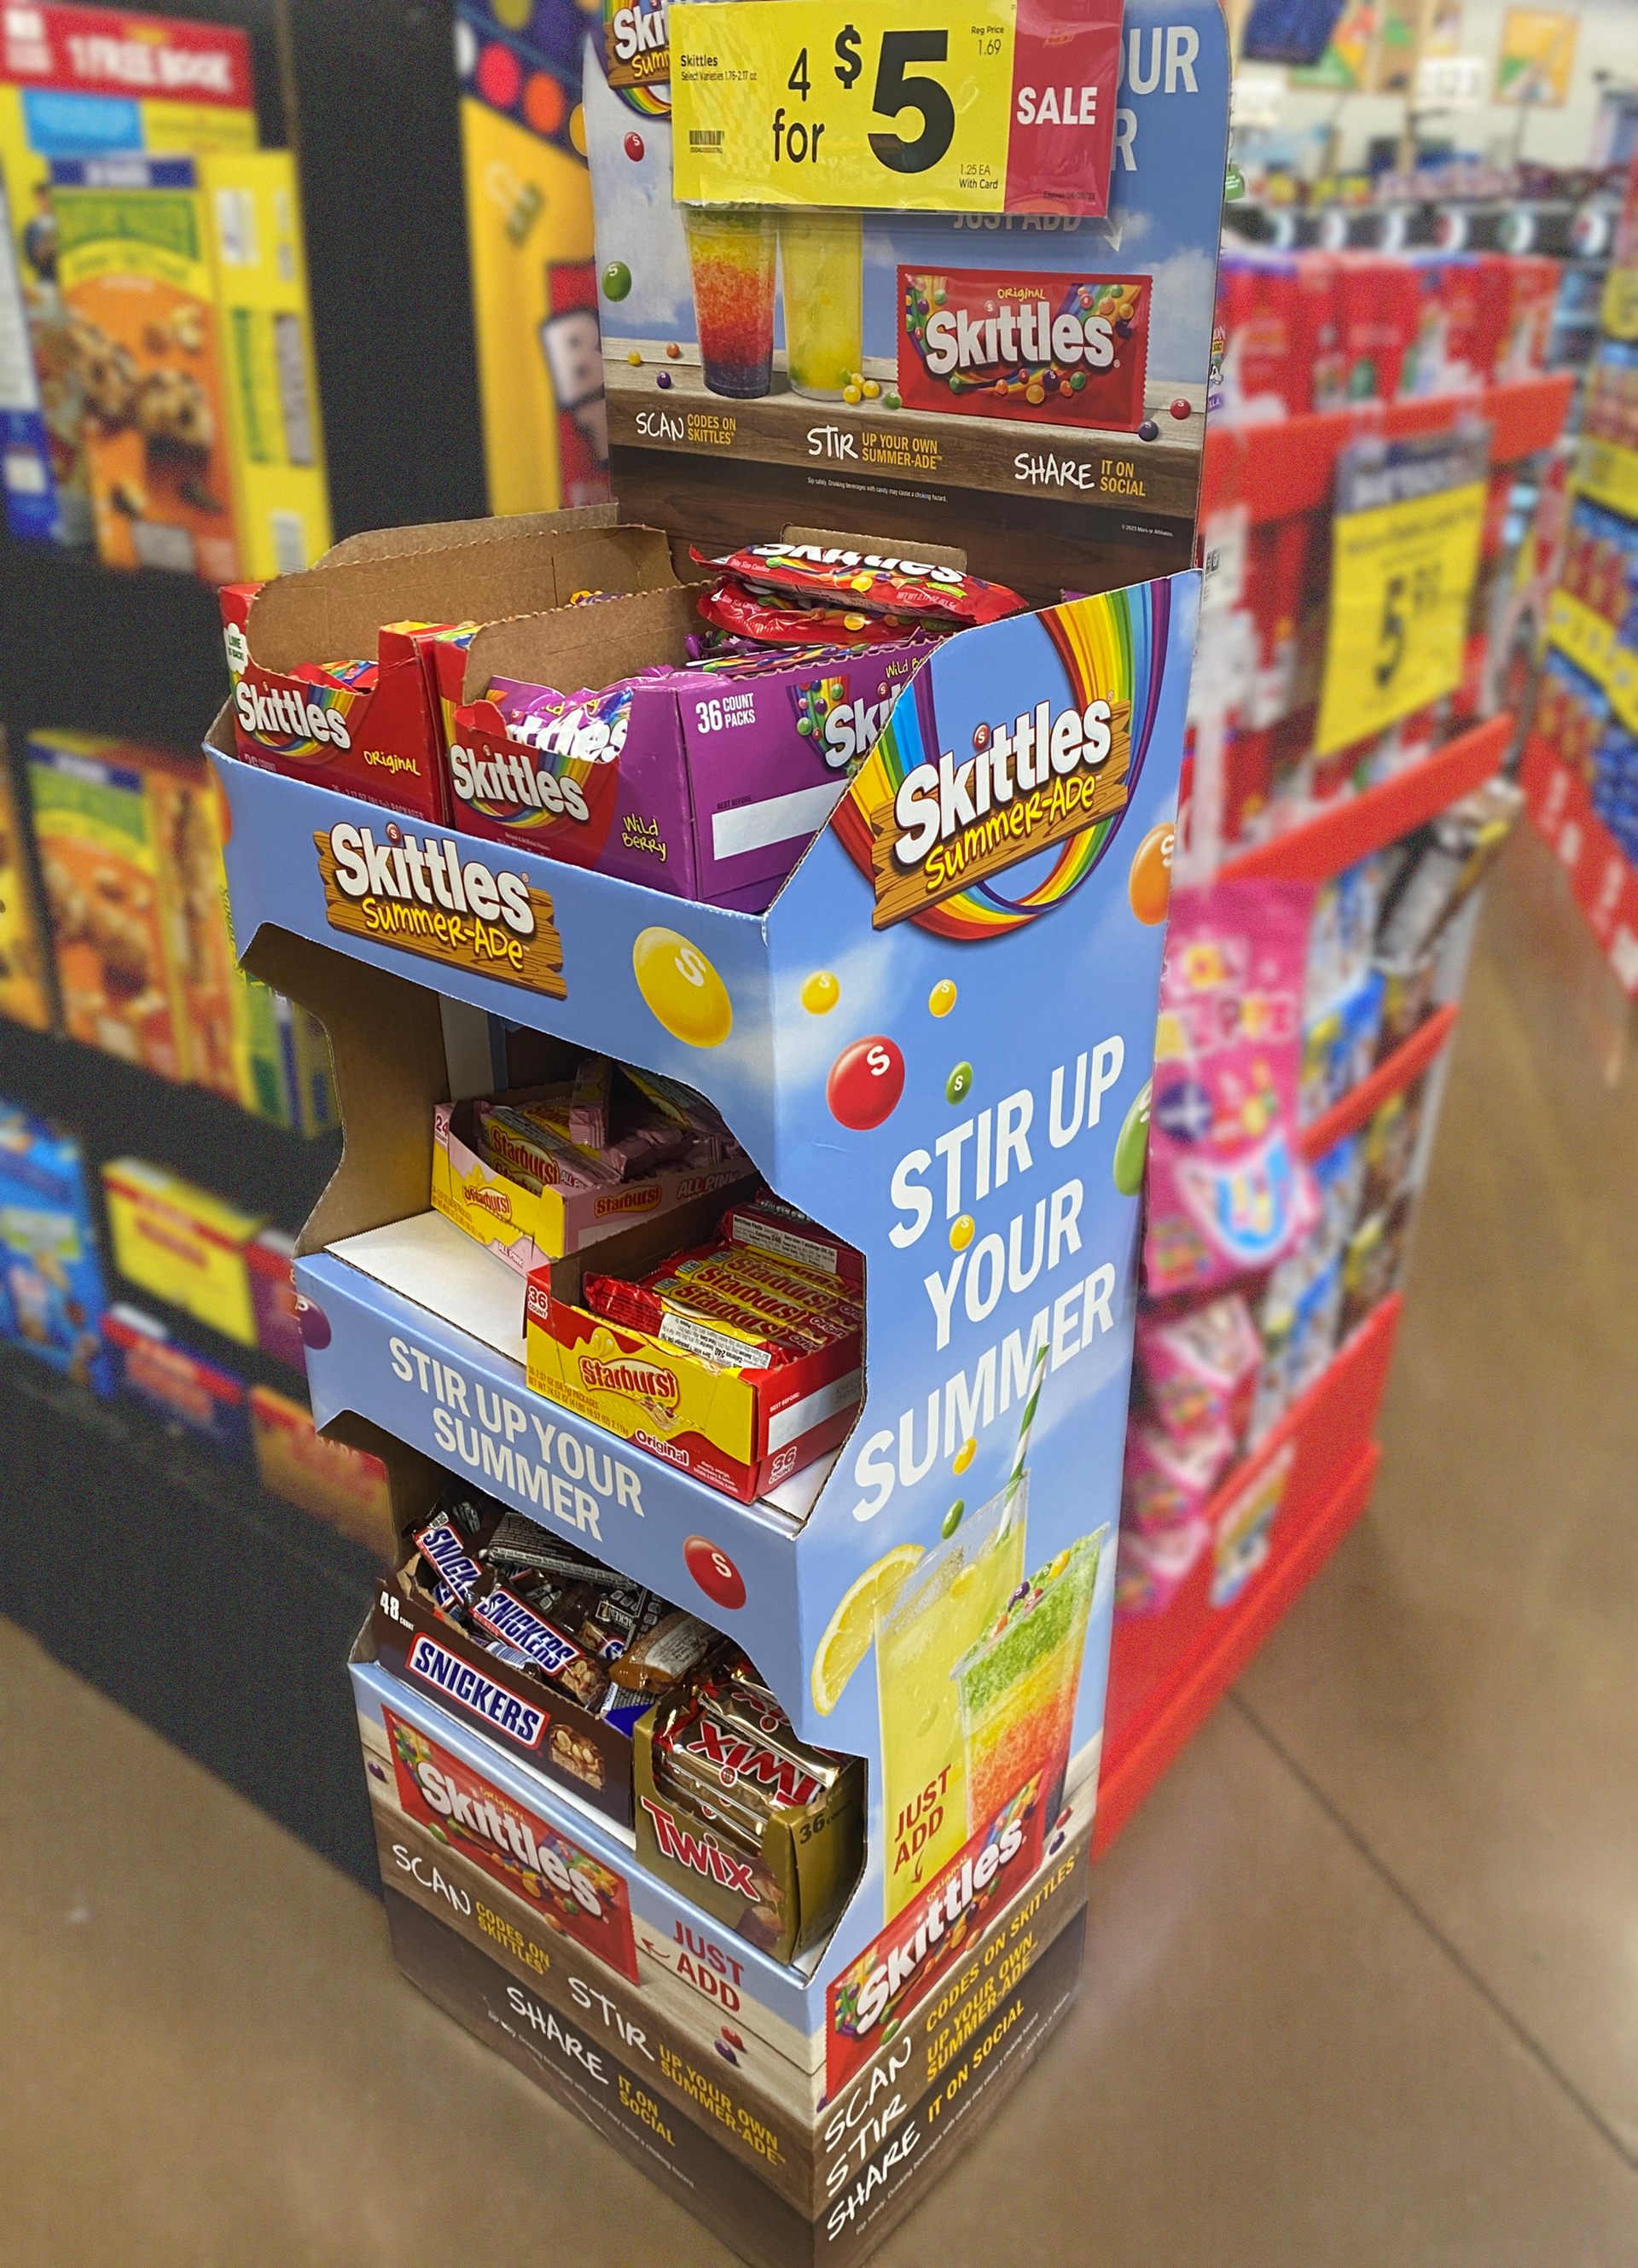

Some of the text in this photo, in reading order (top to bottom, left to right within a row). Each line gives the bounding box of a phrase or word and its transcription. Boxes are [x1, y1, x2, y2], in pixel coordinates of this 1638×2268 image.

[971, 26, 1004, 35] Reg Price
[978, 38, 1002, 55] 1.69
[680, 55, 718, 67] Skittles
[681, 71, 699, 81] Select
[700, 71, 724, 81] Varieties
[749, 73, 757, 81] oz
[787, 49, 810, 102] 4
[1016, 86, 1098, 125] SALE
[772, 108, 824, 165] for
[959, 178, 998, 189] With Card
[960, 164, 991, 176] 1.25 EA
[926, 301, 1114, 375] Skittles
[636, 412, 684, 441] SCAN
[687, 413, 736, 432] CODES ON
[806, 425, 859, 460] STIR
[862, 432, 938, 455] UP YOUR OWN
[828, 480, 845, 489] Drinking
[845, 481, 867, 491] beverages
[876, 486, 888, 495] candy
[1014, 452, 1095, 490] SHARE
[1100, 476, 1146, 497] SOCIAL
[1101, 459, 1135, 478] IT ON
[235, 681, 351, 749] Skittles
[694, 700, 722, 734] 36
[722, 693, 755, 712] COUNT
[723, 709, 757, 730] PACKS
[450, 744, 590, 822] Skittles
[895, 700, 1112, 865] Skittles
[717, 800, 731, 811] BEST
[329, 822, 535, 934] Skittles
[436, 1114, 449, 1134] 24
[888, 1035, 1125, 1249] STIR UP
[491, 1127, 560, 1185] Starburst
[561, 1172, 574, 1186] ALL
[677, 1170, 739, 1199] ALL PINK
[595, 1187, 661, 1214] Starburst
[498, 1242, 509, 1255] ALL
[771, 1234, 781, 1244] 240
[728, 1255, 839, 1311] Starburst
[924, 1178, 1083, 1352] YOUR
[528, 1287, 548, 1308] 36
[528, 1302, 548, 1319] COUNT
[674, 1282, 790, 1339] Starburst
[696, 1265, 809, 1323] Starburst
[810, 1316, 847, 1338] Origin
[528, 1375, 537, 1387] NET
[580, 1357, 677, 1398] Starburst
[851, 1262, 1116, 1523] SUMMER
[572, 1389, 599, 1410] PACKAGES
[770, 1401, 781, 1412] BEST
[389, 1336, 646, 1518] STIR UP YOUR
[636, 1429, 689, 1466] Original
[773, 1446, 798, 1474] 36
[432, 1407, 603, 1543] SUMMER
[770, 1464, 794, 1484] COUNT
[380, 1591, 400, 1621] 48
[415, 1640, 540, 1742] SNICKERS
[895, 1763, 953, 1843] JUST
[417, 1761, 601, 1916] Skittles
[799, 1812, 826, 1845] 36
[893, 1805, 944, 1876] ADD
[392, 1844, 471, 1916] SCAN
[476, 1900, 550, 1969] CODES ON
[856, 1818, 1022, 2035] Skittles
[673, 1919, 745, 1987] JUST
[676, 1952, 741, 2013] ADD
[507, 1986, 609, 2085] SHARE
[568, 1976, 655, 2062] STIR
[825, 2035, 912, 2154] SCAN
[926, 1966, 980, 2032] CODES
[984, 1932, 1006, 1966] ON
[826, 1931, 1033, 2198] STIR UP YOUR OWN
[618, 2074, 659, 2118] IT ON
[659, 2044, 778, 2151] UP YOUR OWN
[619, 2091, 676, 2148] SOCIAL
[828, 1998, 1025, 2242] SHARE IT ON SOCIAL
